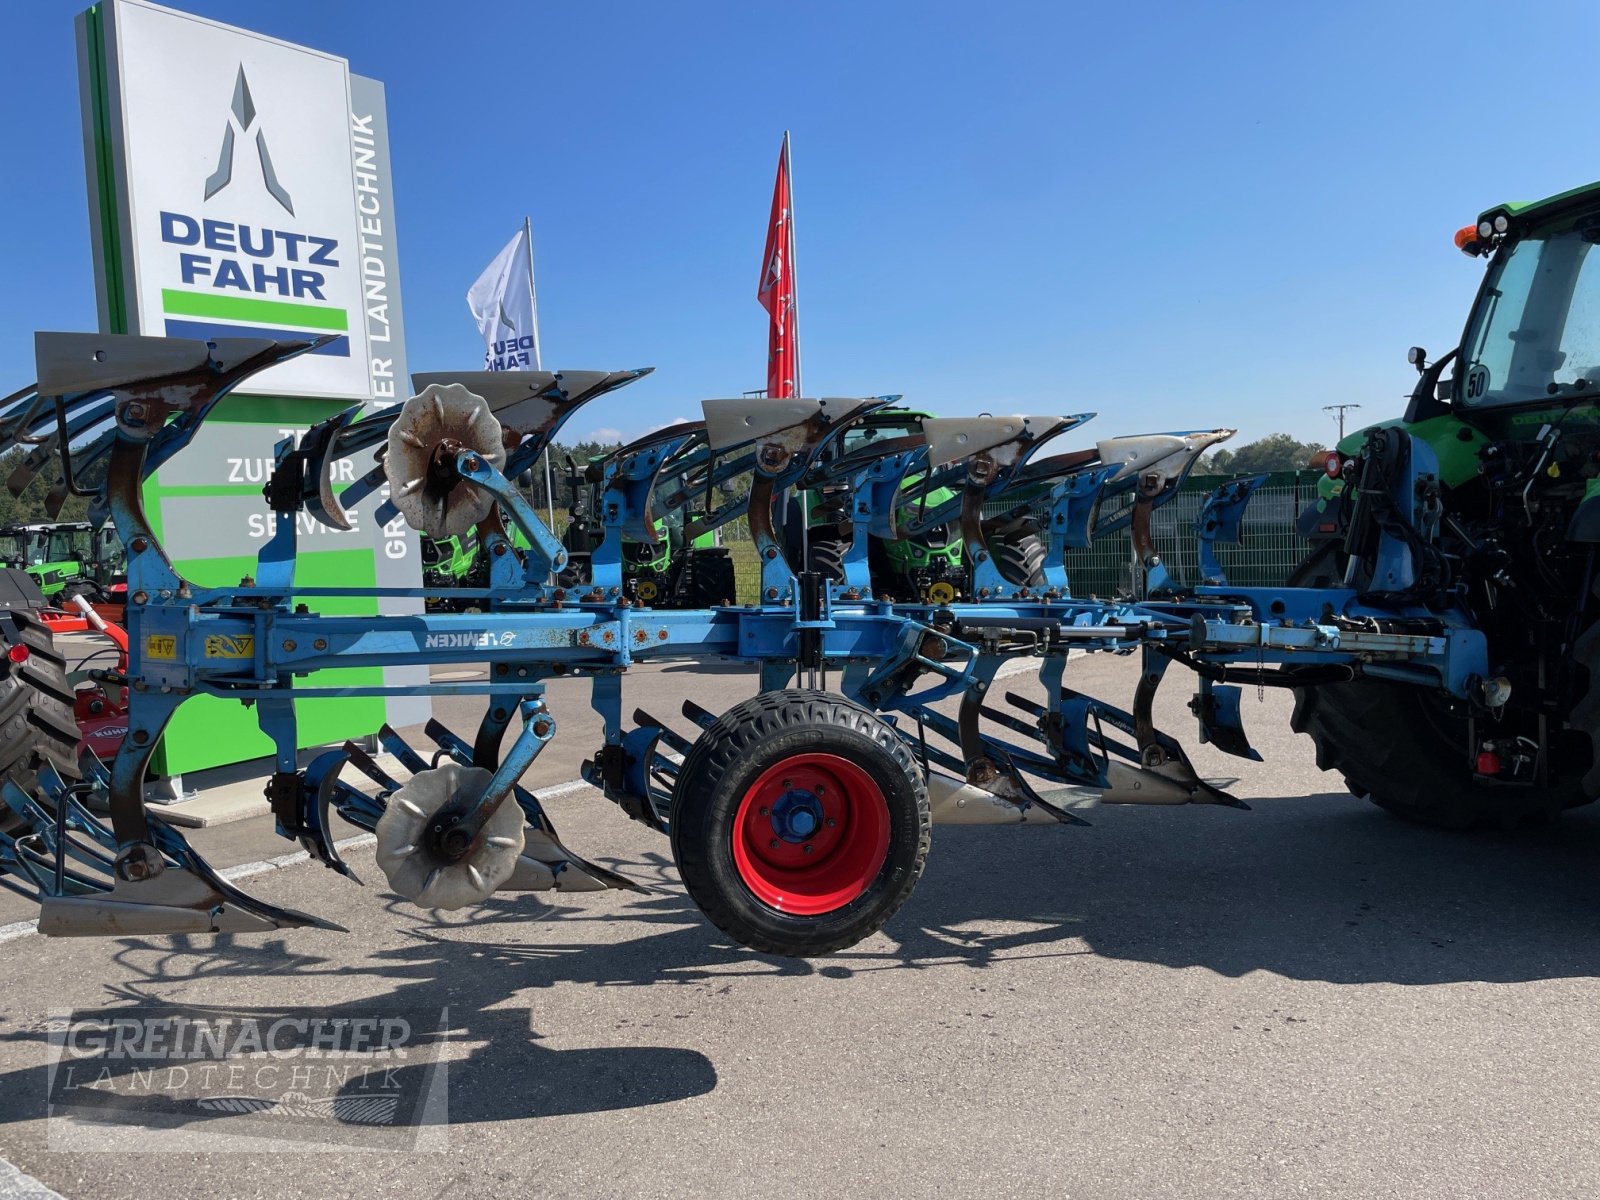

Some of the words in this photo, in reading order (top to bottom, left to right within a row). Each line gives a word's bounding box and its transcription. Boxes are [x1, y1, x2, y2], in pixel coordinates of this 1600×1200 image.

[159, 210, 339, 268] DEUTZ
[351, 112, 391, 343] LANDTECHNIK
[179, 252, 328, 301] FAHR
[1467, 371, 1484, 398] 50
[425, 630, 499, 648] LEMKEN
[95, 727, 129, 738] KUHN
